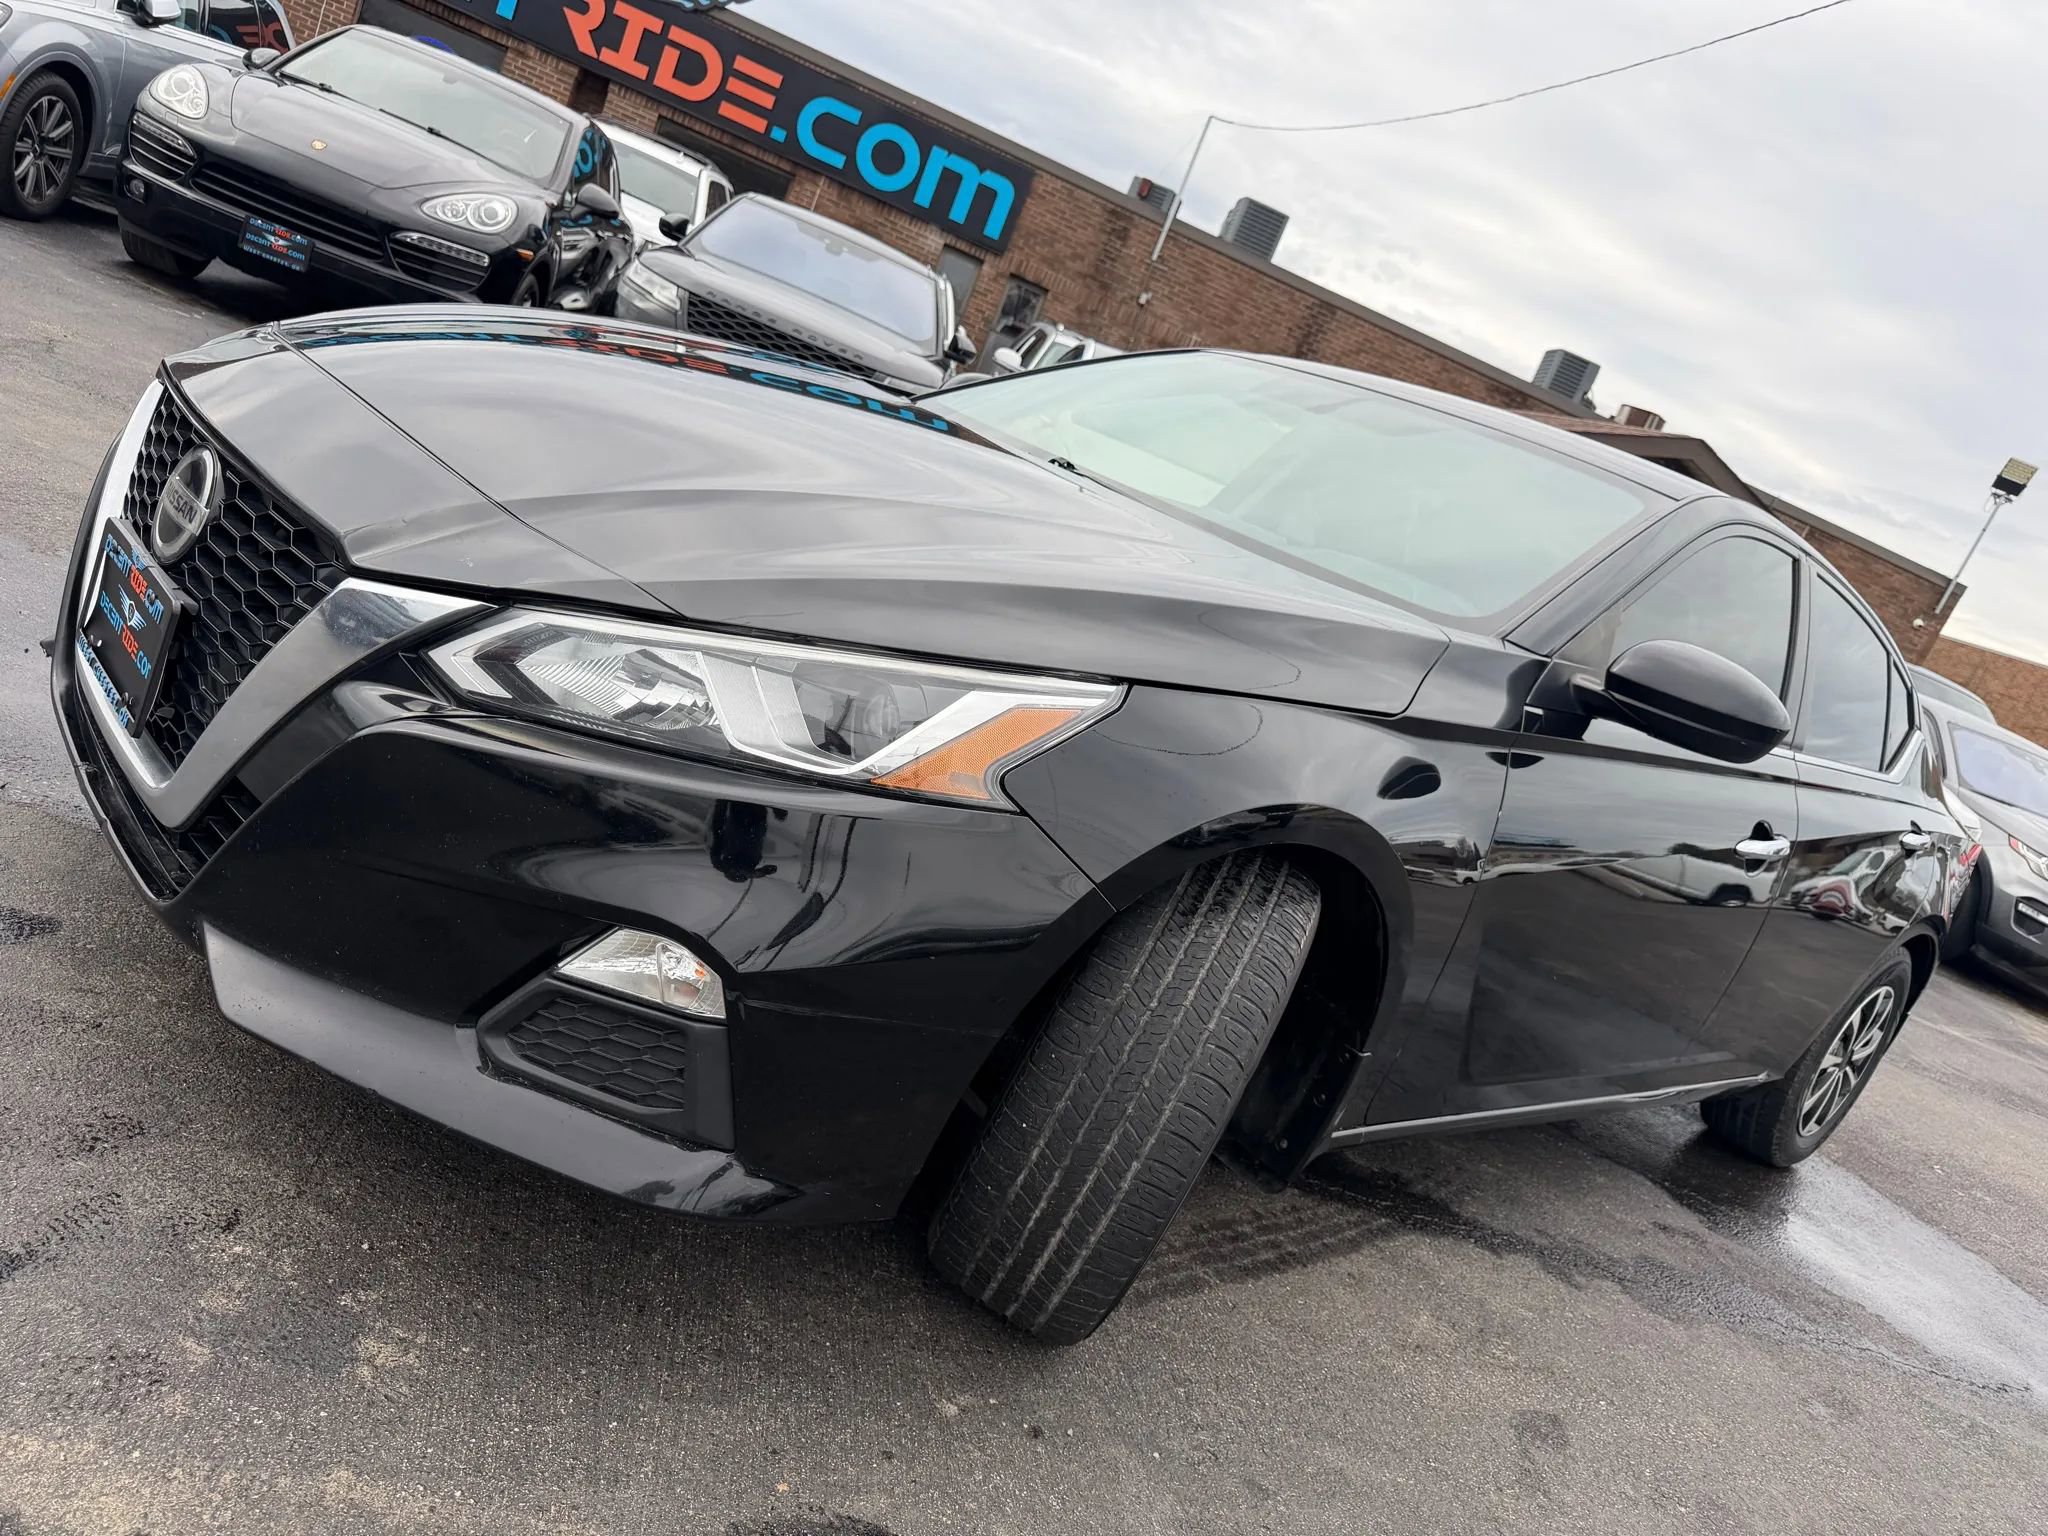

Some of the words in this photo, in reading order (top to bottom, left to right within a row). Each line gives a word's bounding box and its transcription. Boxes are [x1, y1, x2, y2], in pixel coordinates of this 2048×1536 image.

[706, 290, 778, 324] RANGE
[791, 327, 865, 361] ROVER
[165, 480, 198, 525] NISSAN
